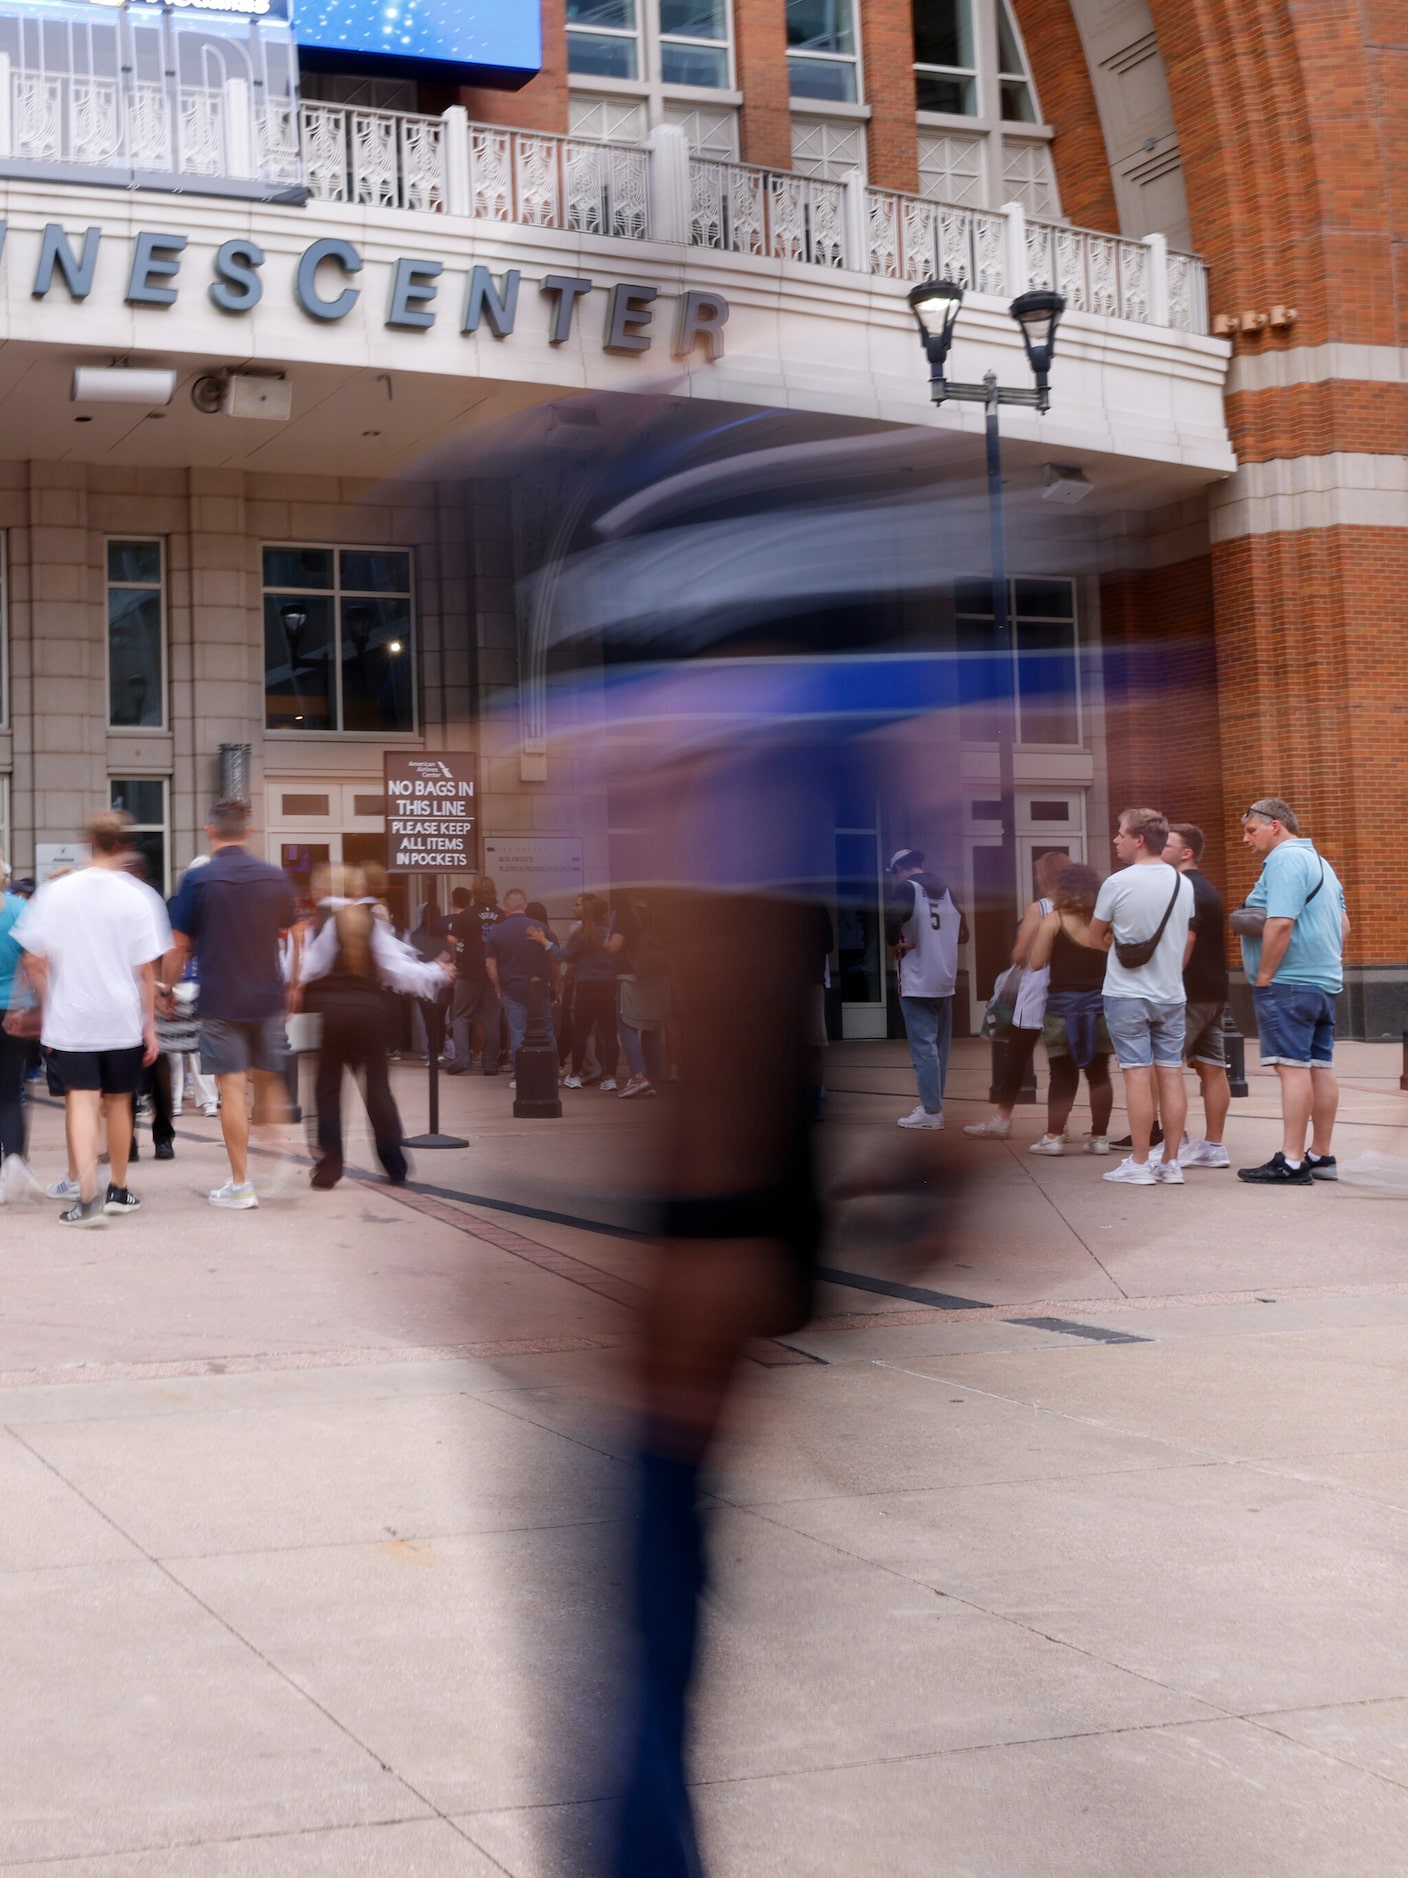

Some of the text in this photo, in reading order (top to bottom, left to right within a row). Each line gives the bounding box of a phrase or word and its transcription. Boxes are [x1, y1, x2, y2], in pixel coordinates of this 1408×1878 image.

[296, 238, 730, 361] CENTER
[388, 780, 474, 797] NO BAGS IN
[396, 799, 466, 816] THIS LINE
[392, 821, 471, 835] PLEASE KEEP
[400, 837, 464, 850] ALL ITEMS
[396, 852, 468, 866] IN POCKETS
[929, 902, 941, 931] 5
